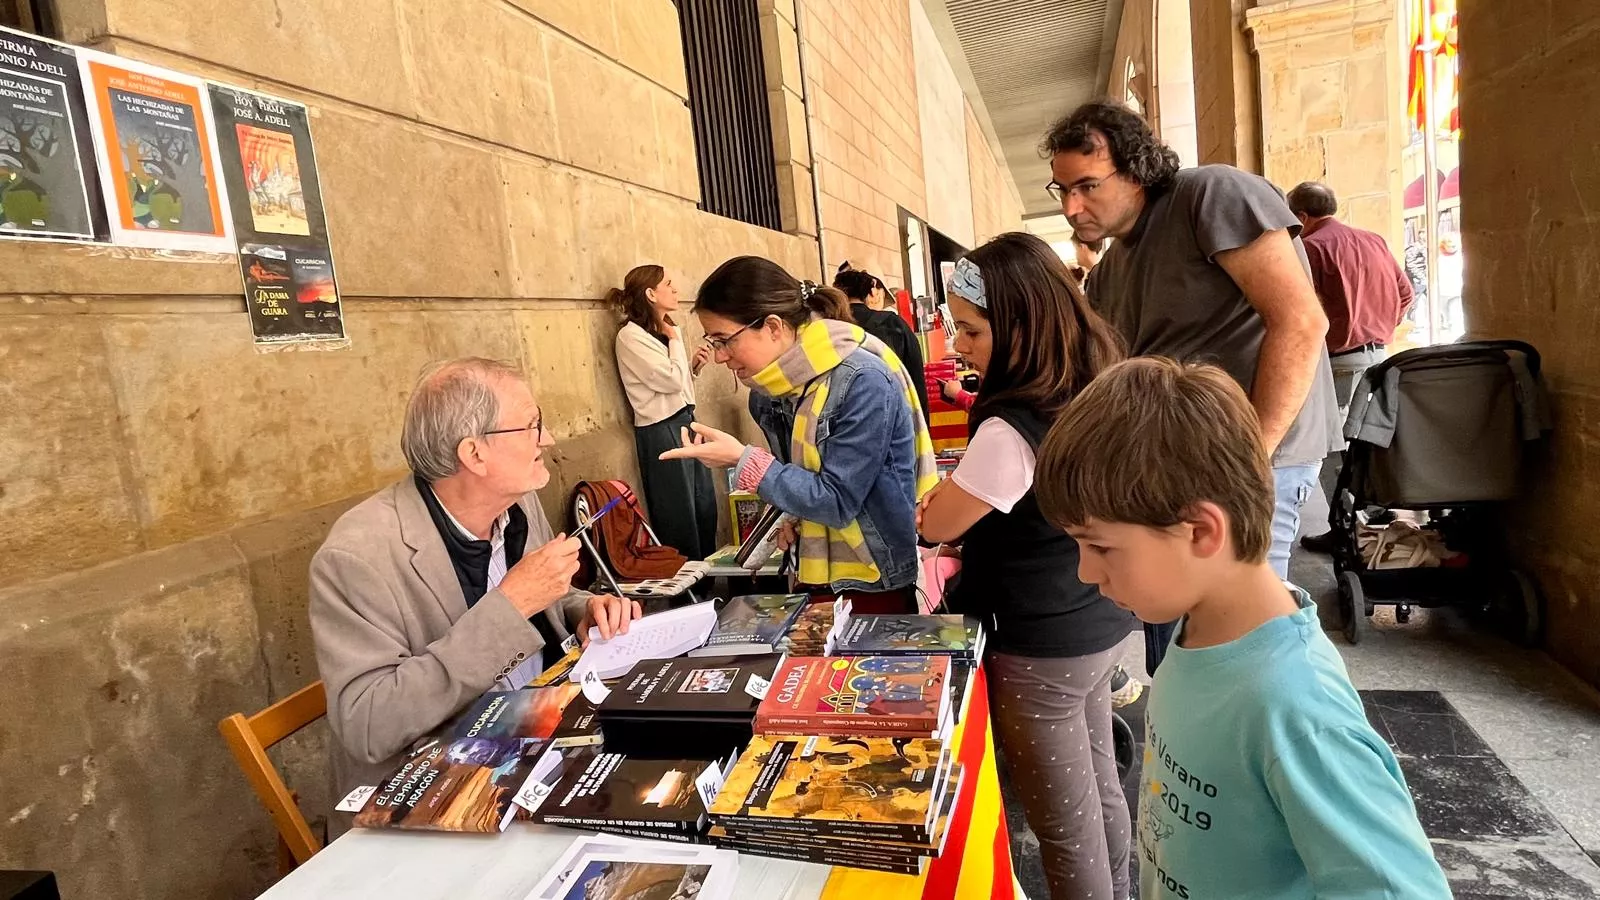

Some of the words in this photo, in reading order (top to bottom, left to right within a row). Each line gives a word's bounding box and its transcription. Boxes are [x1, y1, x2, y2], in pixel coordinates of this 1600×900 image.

[30, 60, 67, 77] ADELL
[41, 87, 54, 96] DE
[117, 94, 131, 103] LAS
[132, 97, 174, 112] HECHIZADAS
[175, 106, 185, 115] DE
[126, 104, 141, 113] LAS
[142, 107, 180, 121] MONTAÑAS
[234, 95, 253, 108] HOY
[259, 101, 286, 116] FIRMA
[264, 114, 291, 128] ADELL
[267, 299, 279, 307] DE
[269, 292, 290, 300] DAMA
[261, 307, 289, 316] GUARA
[777, 664, 808, 703] GADEA
[467, 695, 506, 738] CUCARACHA
[389, 760, 431, 807] TEMPLARIO
[427, 747, 442, 760] DE
[1158, 736, 1218, 799] Verano
[376, 795, 390, 806] EL
[385, 763, 414, 793] ÚLTIMO
[406, 769, 440, 808] ARAGÓN
[346, 786, 373, 808] 15€
[521, 784, 550, 807] 15€
[1160, 782, 1212, 831] 2019
